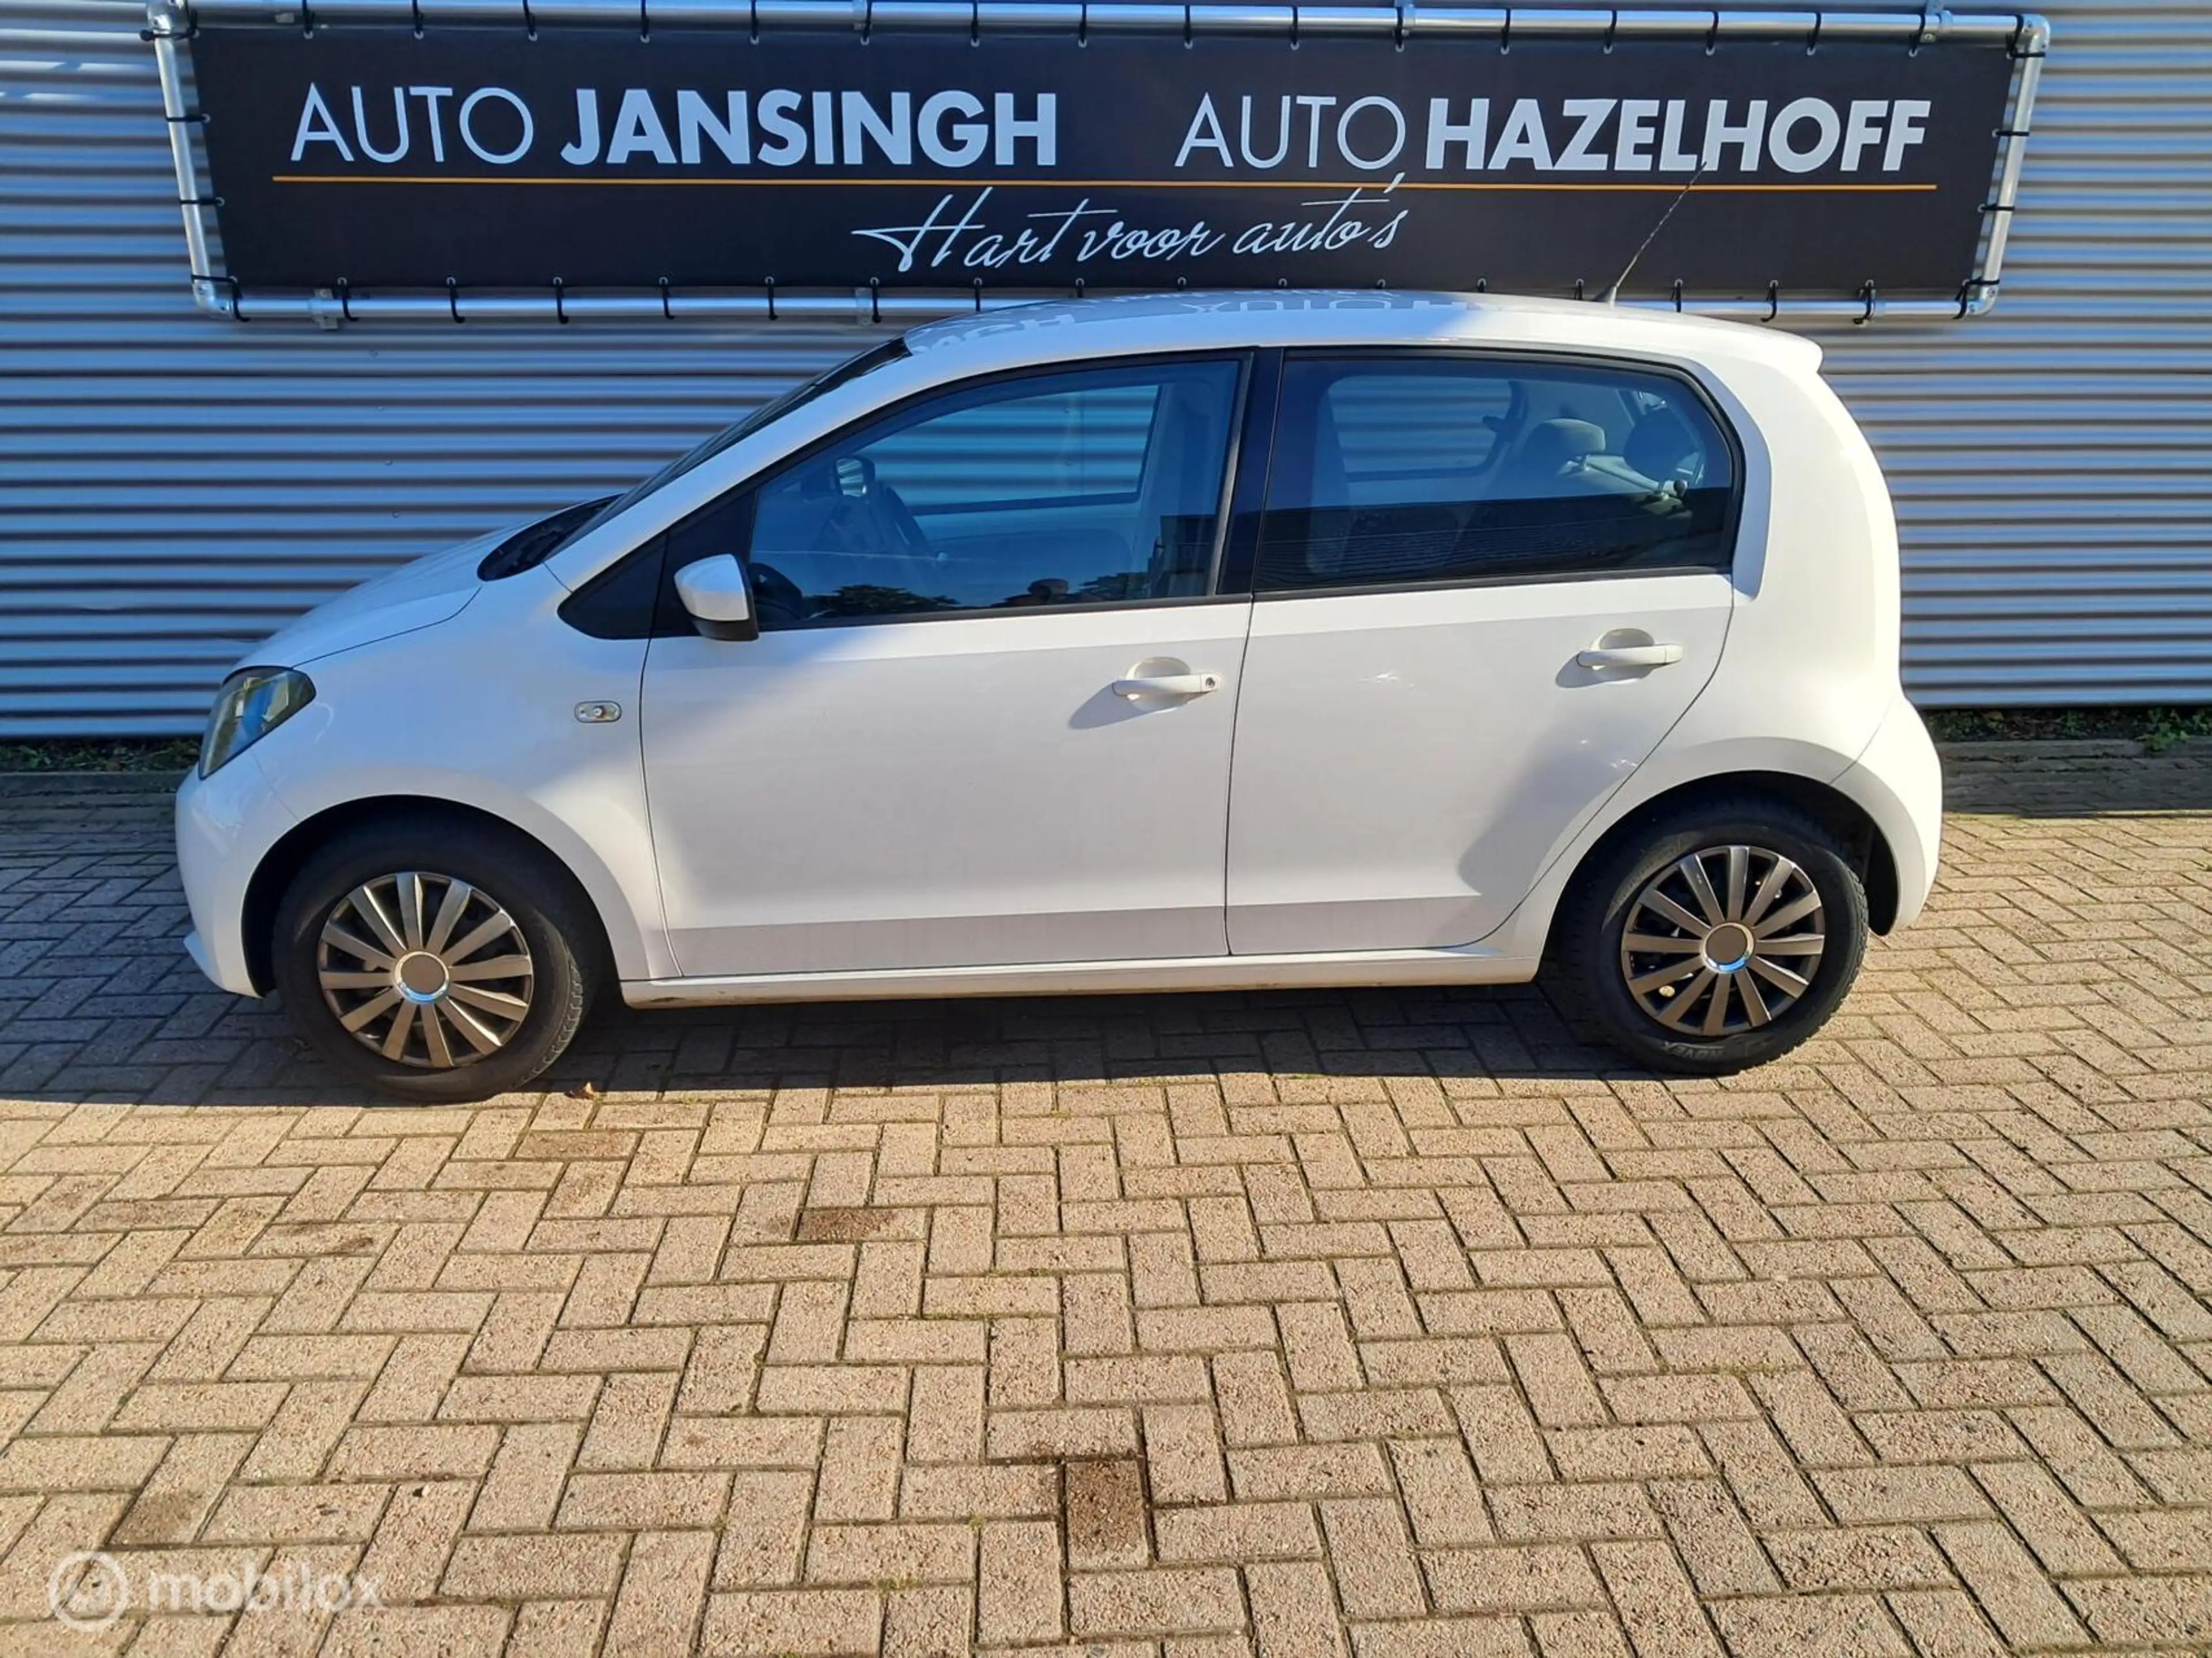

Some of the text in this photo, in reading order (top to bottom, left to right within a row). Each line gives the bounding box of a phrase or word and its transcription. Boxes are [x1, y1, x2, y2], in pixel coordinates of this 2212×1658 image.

[290, 82, 1056, 167] AUTO JANSINGH
[1174, 92, 1932, 173] AUTO HAZELHOFF
[851, 172, 1410, 272] Hart voor auto's
